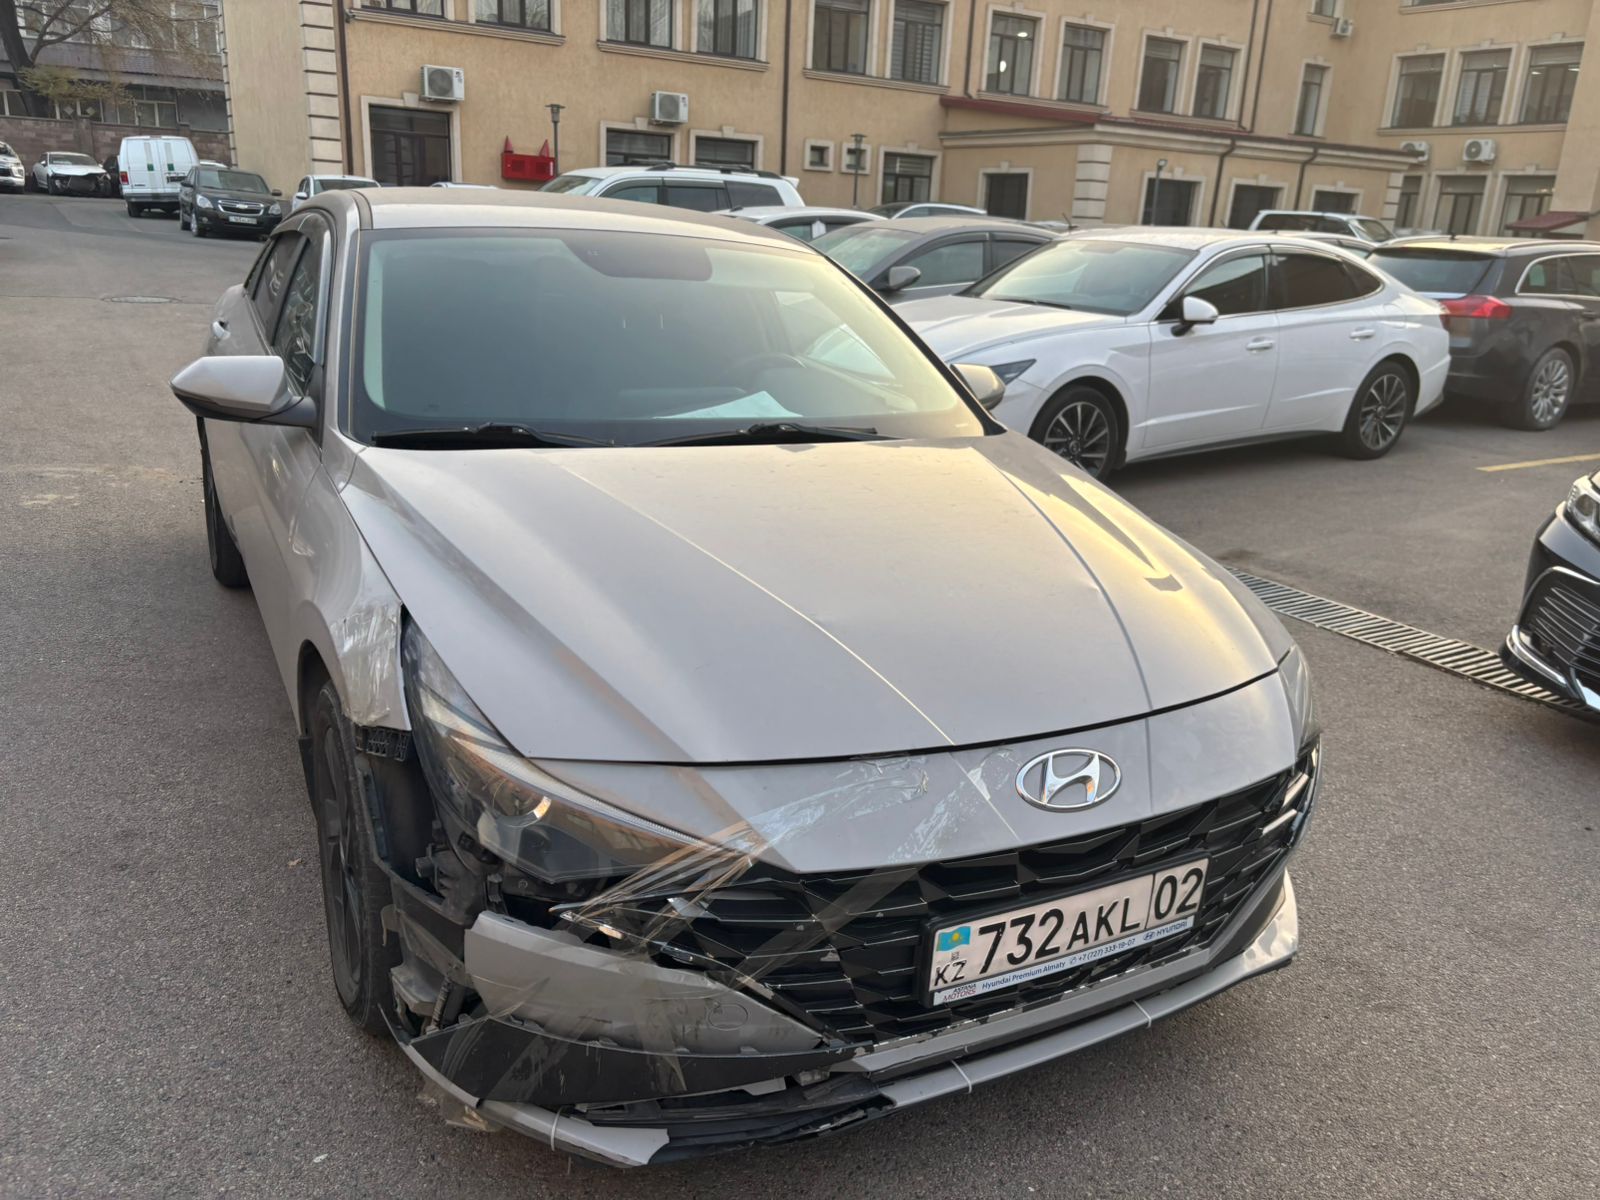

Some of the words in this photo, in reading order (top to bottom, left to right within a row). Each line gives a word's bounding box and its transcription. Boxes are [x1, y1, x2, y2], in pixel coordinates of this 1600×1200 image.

[977, 897, 1141, 975] 732AKL
[1153, 867, 1204, 921] 02
[934, 960, 967, 987] KZ
[982, 975, 1011, 989] Hyundai
[1012, 968, 1043, 982] Premium
[1043, 961, 1066, 974] Almaty
[1157, 921, 1188, 936] HYUNDAI
[943, 988, 976, 1002] MOTORS
